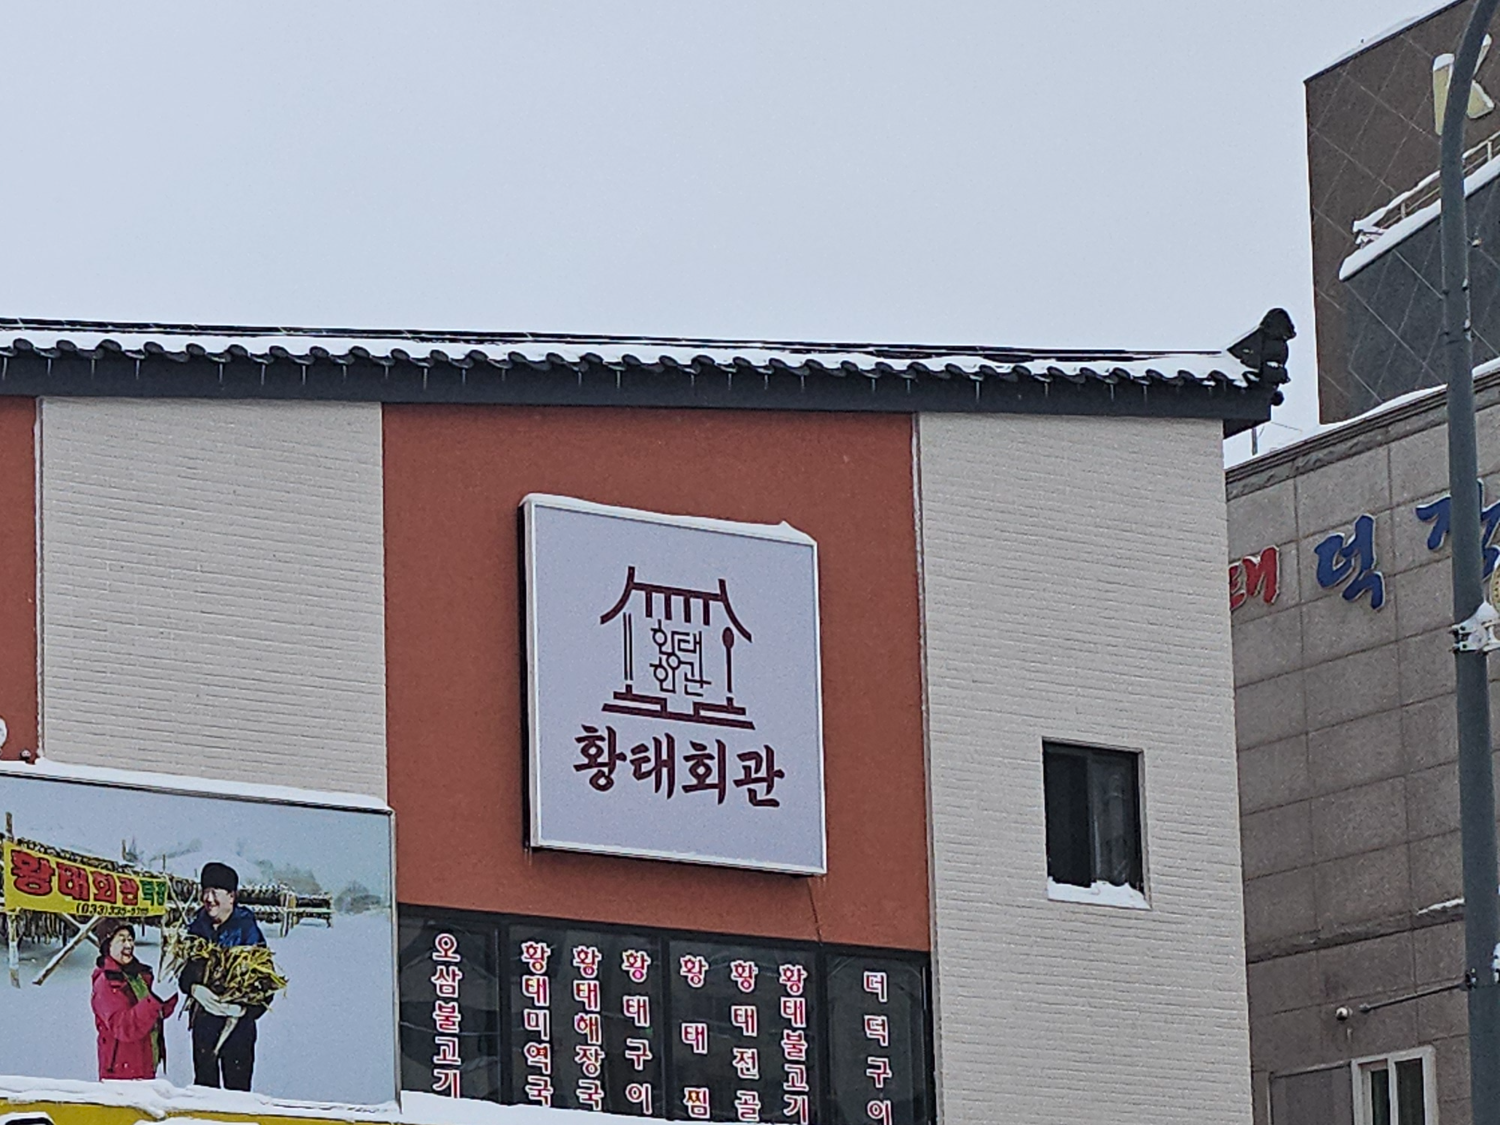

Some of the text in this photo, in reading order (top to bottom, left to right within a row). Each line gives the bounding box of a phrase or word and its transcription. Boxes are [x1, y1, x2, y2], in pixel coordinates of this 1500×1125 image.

[573, 724, 786, 808] 황태회관
[431, 933, 462, 1099] 오삼불고기
[522, 941, 553, 1107] 황태미역국
[573, 946, 604, 1110] 황태해장국
[621, 950, 652, 1114] 황태구이
[680, 955, 710, 1119] 황태찜
[731, 960, 760, 1122] 황태전골
[779, 964, 809, 1125] 황태불고기
